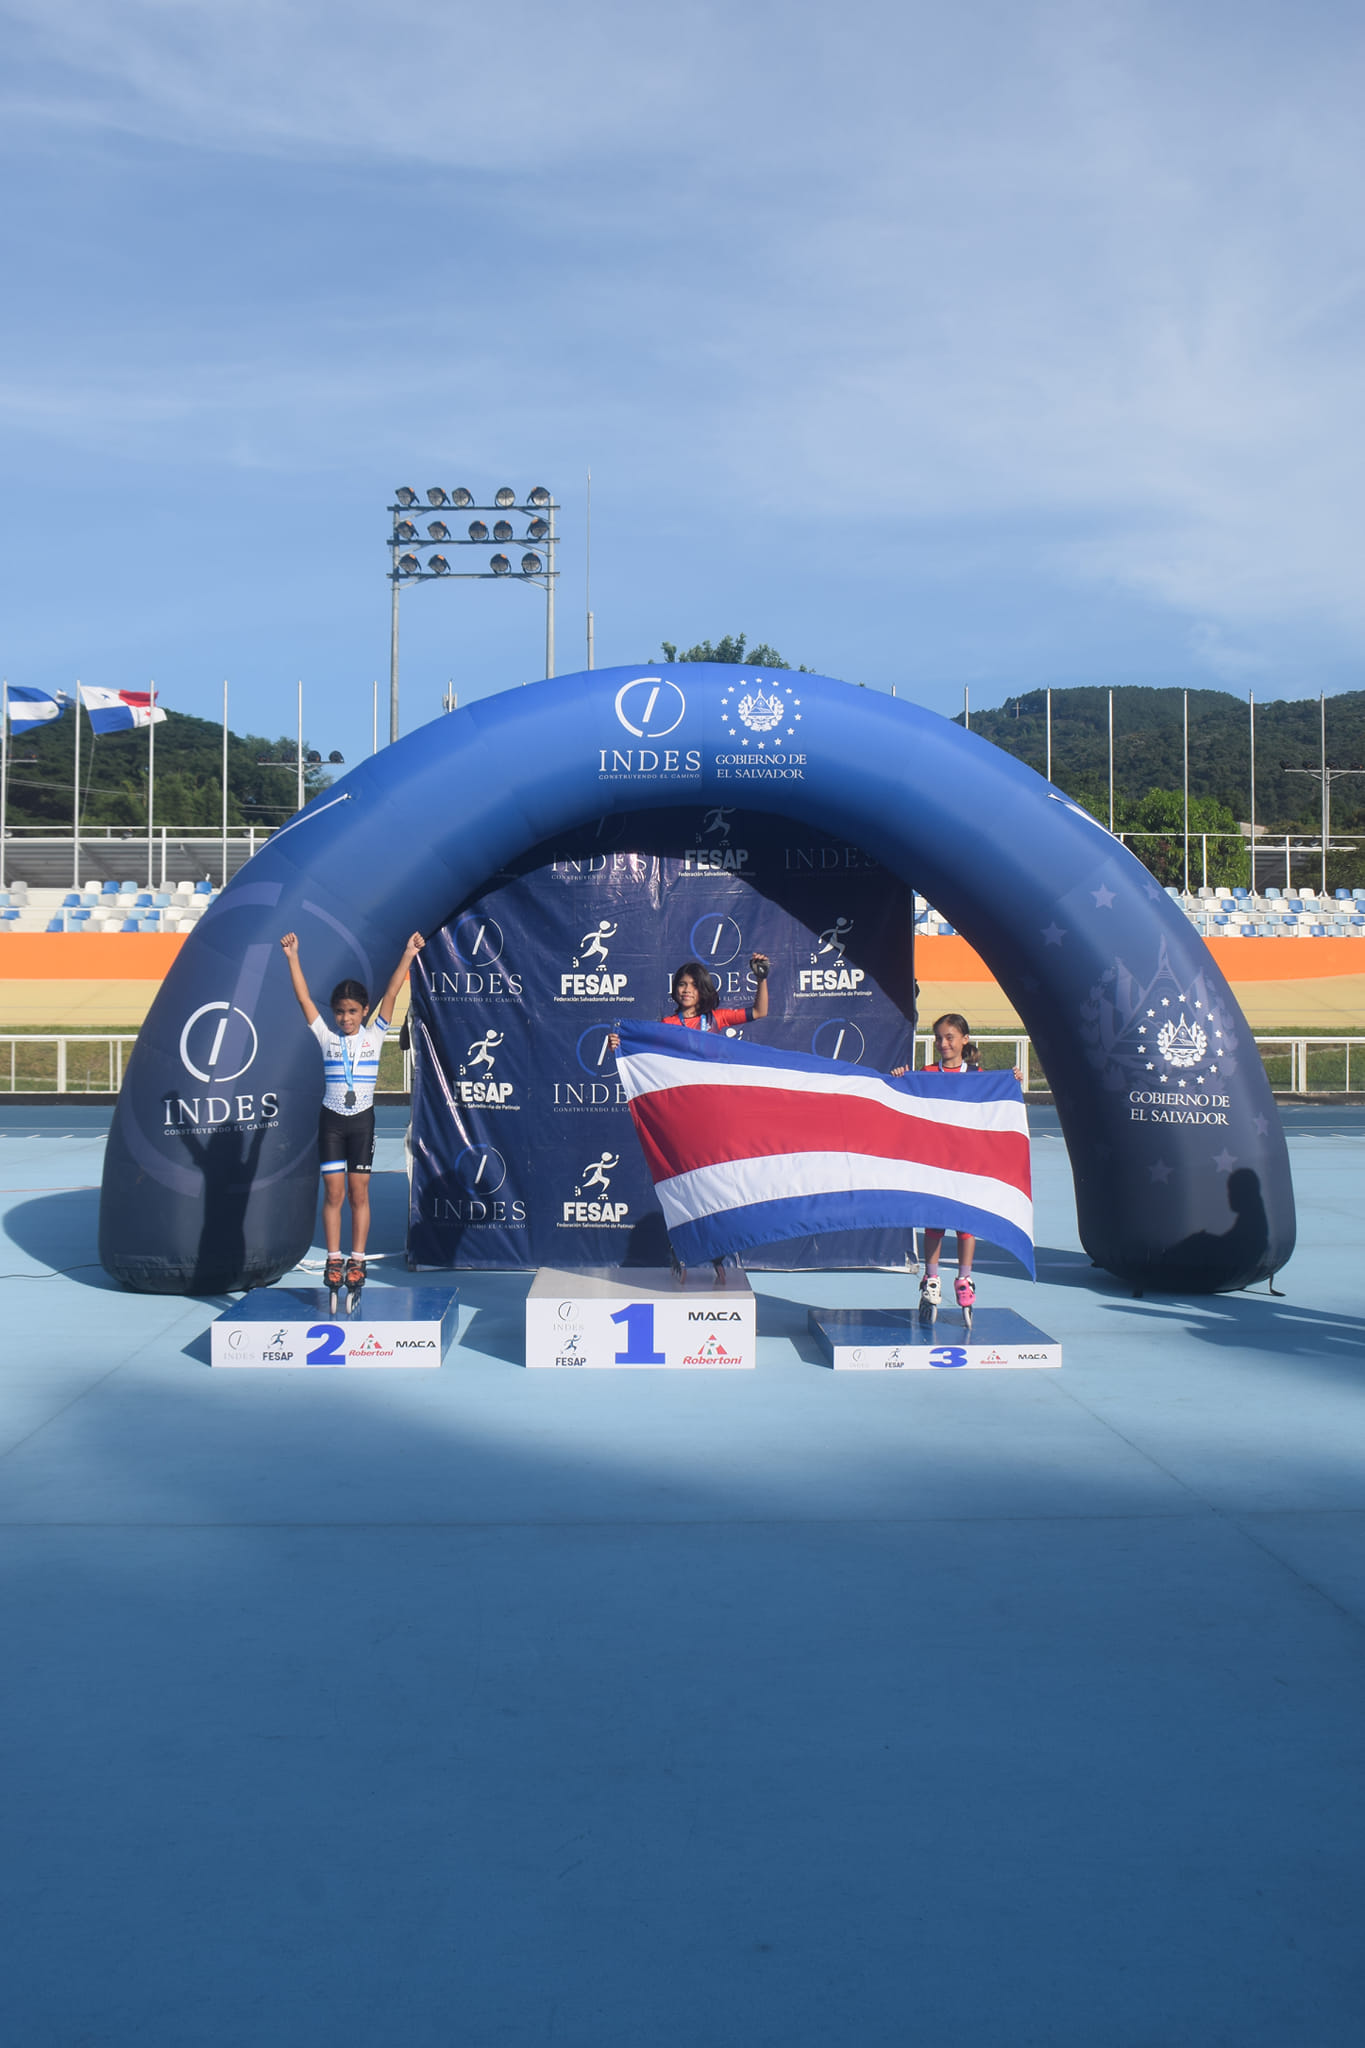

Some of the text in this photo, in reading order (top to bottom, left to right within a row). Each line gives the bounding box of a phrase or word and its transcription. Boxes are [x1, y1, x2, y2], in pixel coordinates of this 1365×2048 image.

[598, 749, 701, 772] INDES
[715, 754, 807, 765] GOBIERNO DE
[717, 768, 805, 780] EL SALVADOR
[551, 853, 647, 873] INDES
[684, 848, 749, 871] FESAP
[430, 971, 523, 995] INDES
[560, 973, 628, 996] FESAP
[666, 970, 759, 994] IDES
[799, 968, 865, 991] FESAP
[453, 1080, 514, 1104] FESAP
[553, 1083, 629, 1105] INDE
[1129, 1091, 1230, 1108] GOBIERNO DE
[163, 1092, 279, 1126] INDES
[1130, 1108, 1230, 1126] EL SALVADOR
[163, 1120, 280, 1136] CONSTRUYENDO EL CAMINO
[434, 1197, 526, 1222] INDES
[563, 1201, 629, 1222] FESAP
[688, 1311, 742, 1321] MACA
[395, 1340, 436, 1348] MACA
[610, 1303, 666, 1364] 1
[306, 1324, 346, 1366] 2
[349, 1348, 394, 1357] Robertoni
[262, 1352, 294, 1361] FESAP
[555, 1357, 587, 1367] FESAP
[682, 1355, 743, 1365] Robertoni
[929, 1346, 968, 1368] 3
